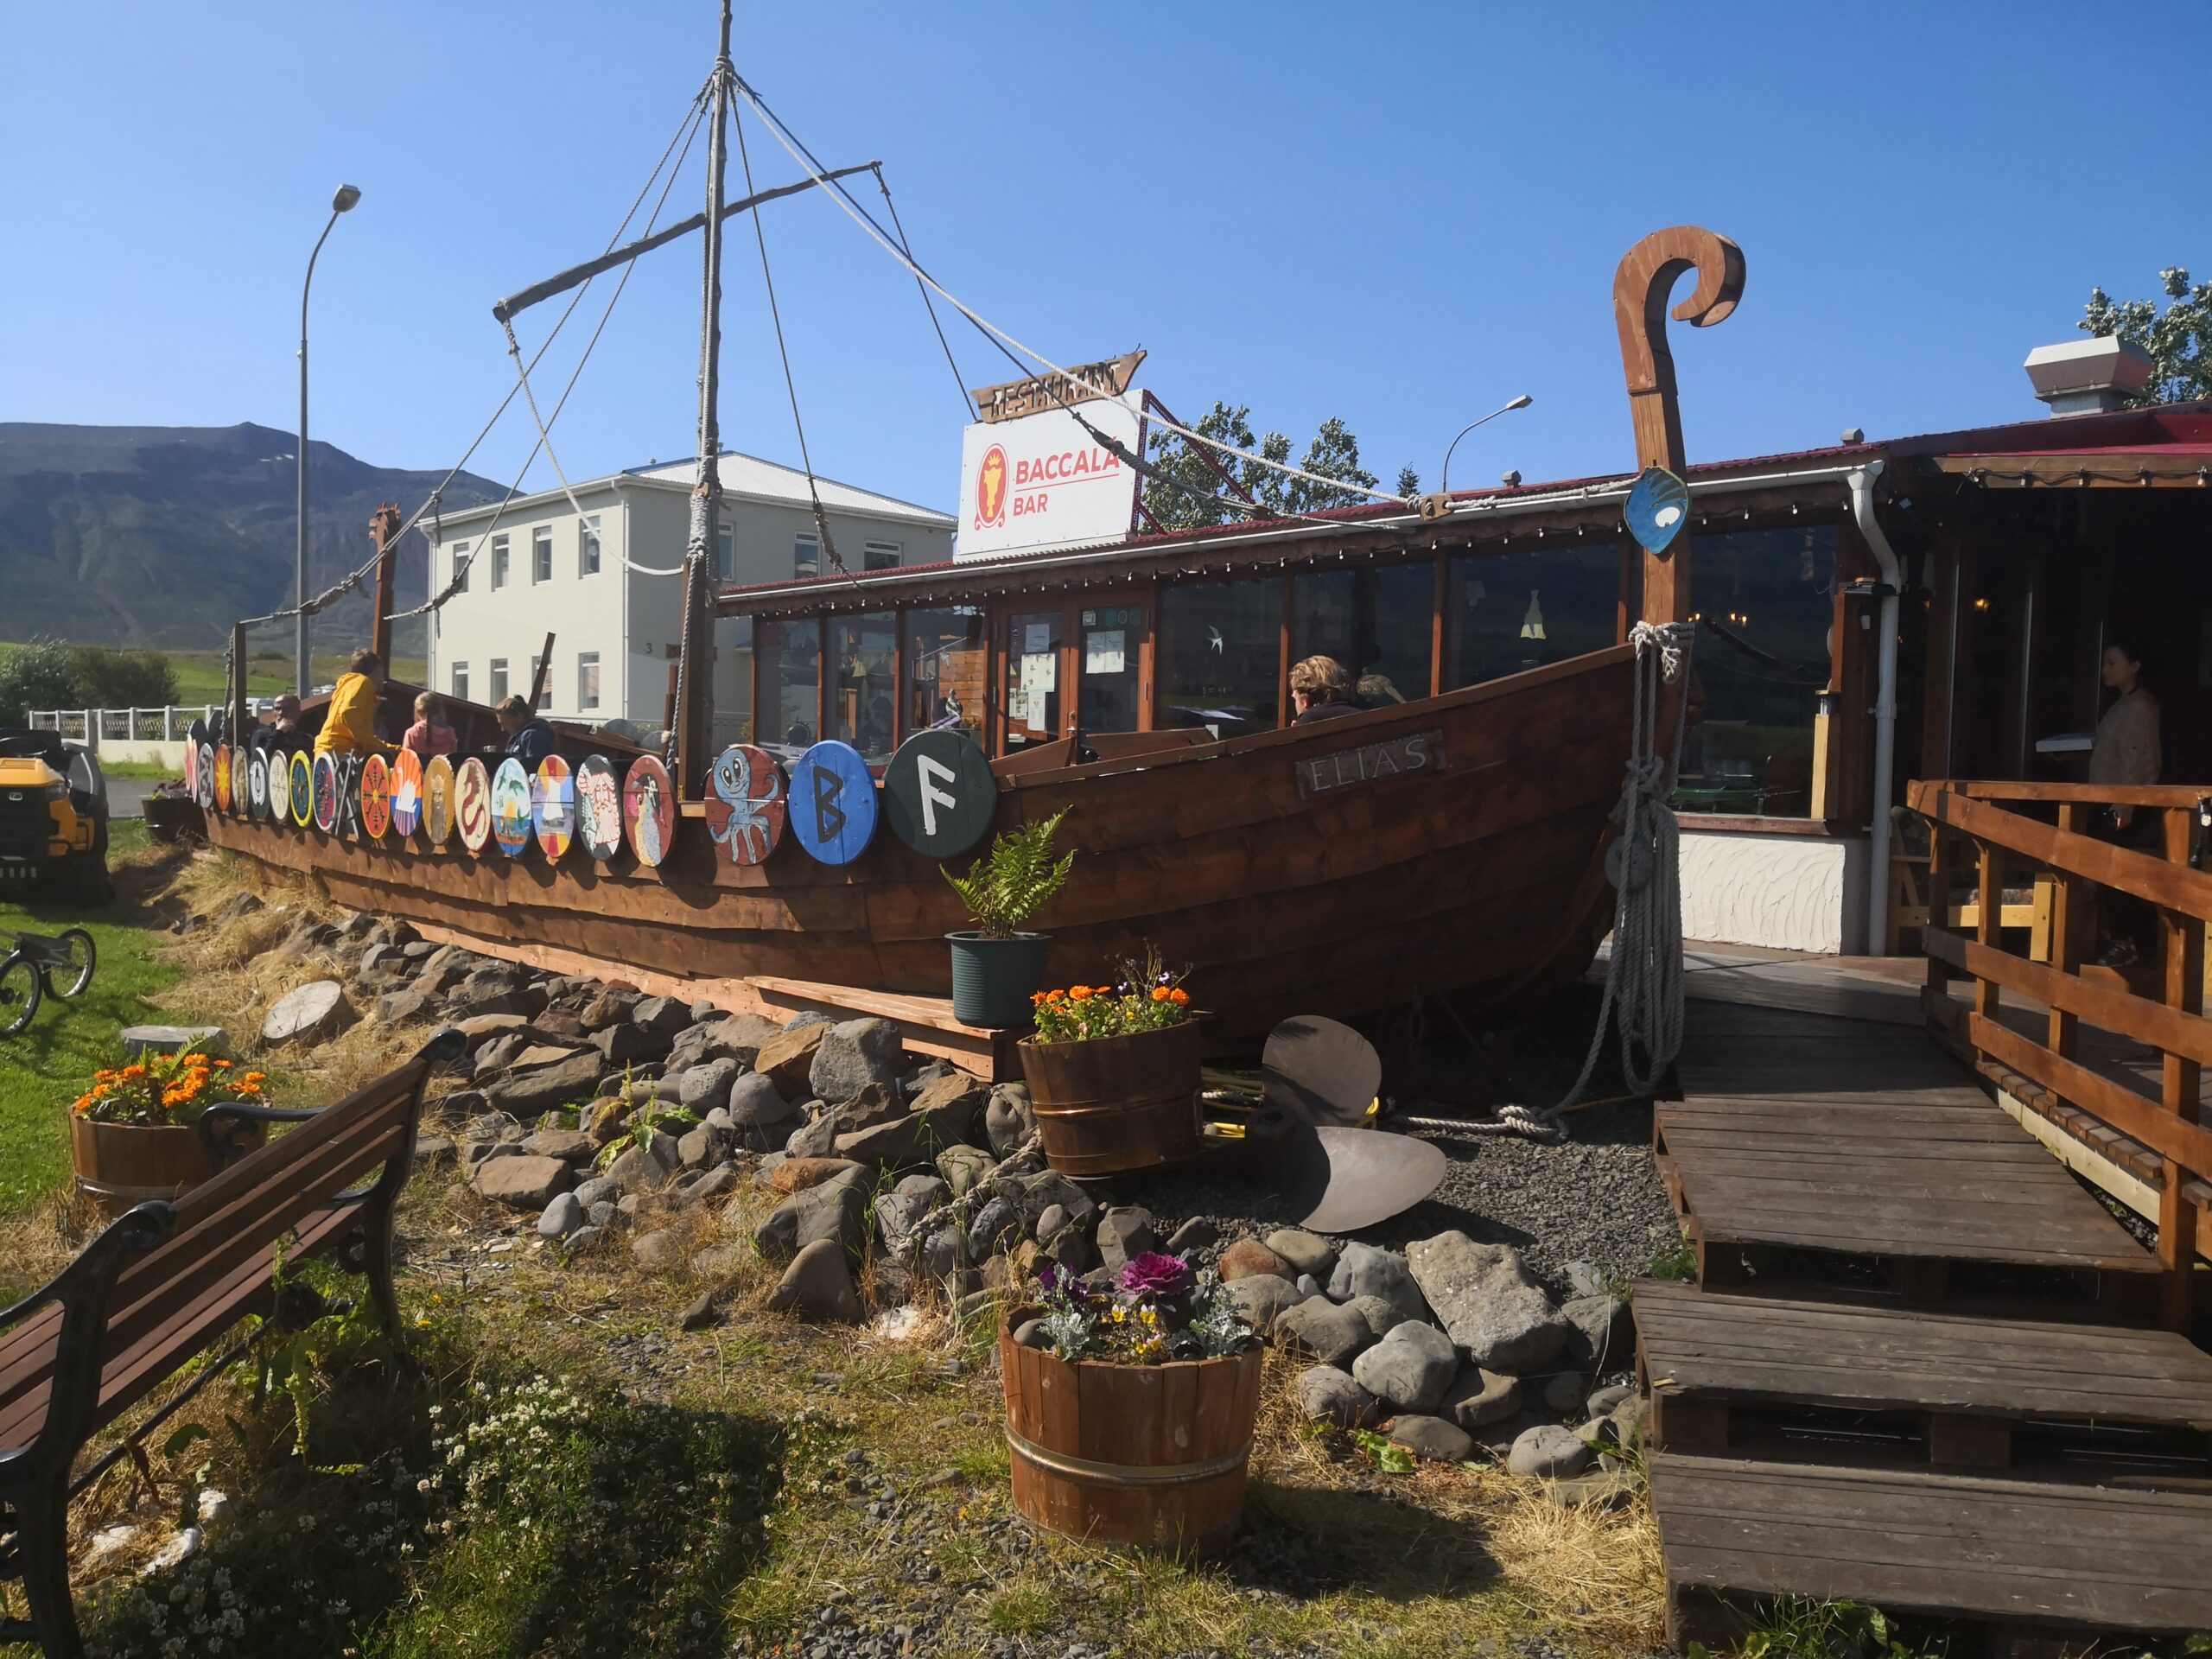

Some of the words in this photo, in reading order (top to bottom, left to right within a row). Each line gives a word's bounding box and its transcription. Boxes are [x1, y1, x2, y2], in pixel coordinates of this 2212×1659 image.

[1014, 493, 1048, 516] BAR
[645, 642, 653, 654] 3
[1310, 739, 1426, 791] ELIAS
